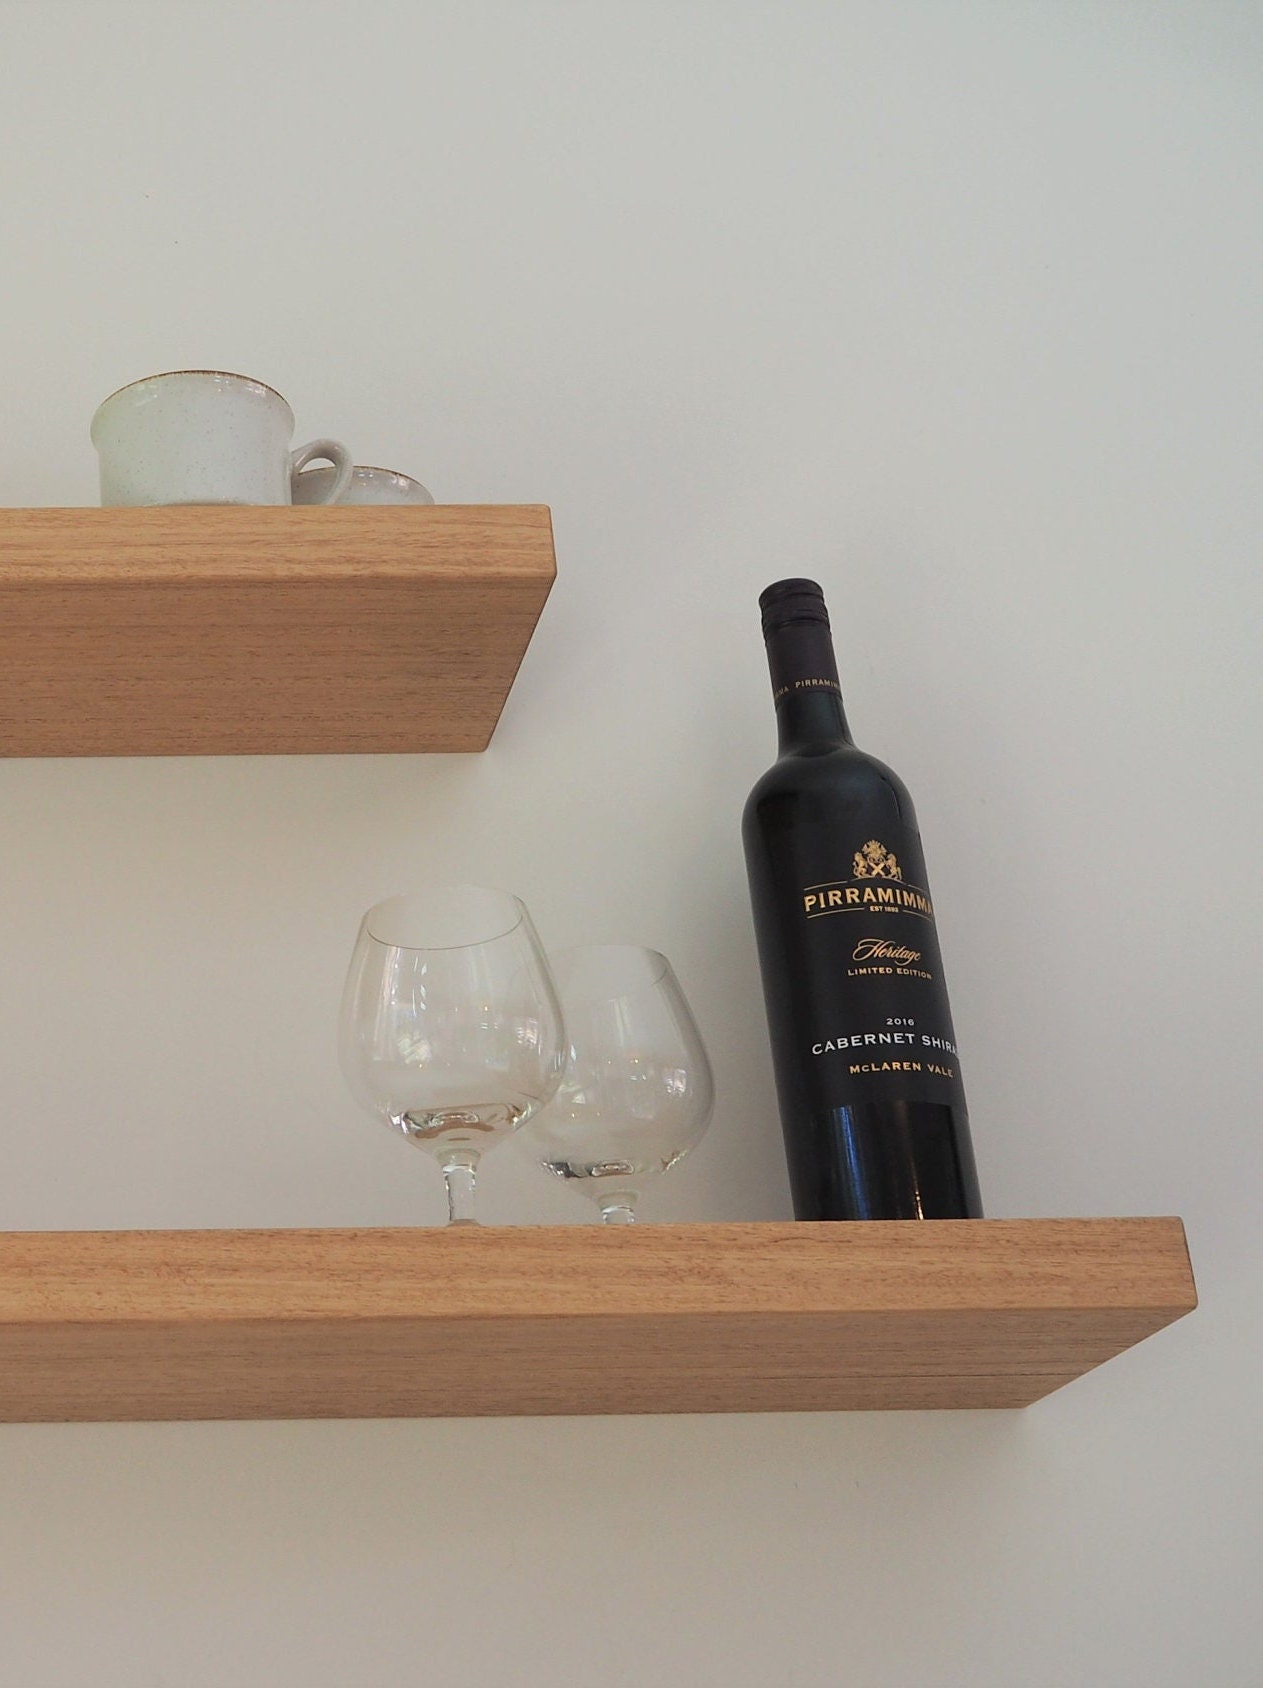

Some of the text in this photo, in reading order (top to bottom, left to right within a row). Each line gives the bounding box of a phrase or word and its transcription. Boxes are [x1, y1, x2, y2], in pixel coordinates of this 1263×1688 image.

[852, 938, 921, 966] Heritage
[847, 967, 932, 980] LIMITED EDITION
[886, 1018, 915, 1026] 2016
[811, 1032, 915, 1055] CABERNET
[927, 1063, 954, 1078] VALE
